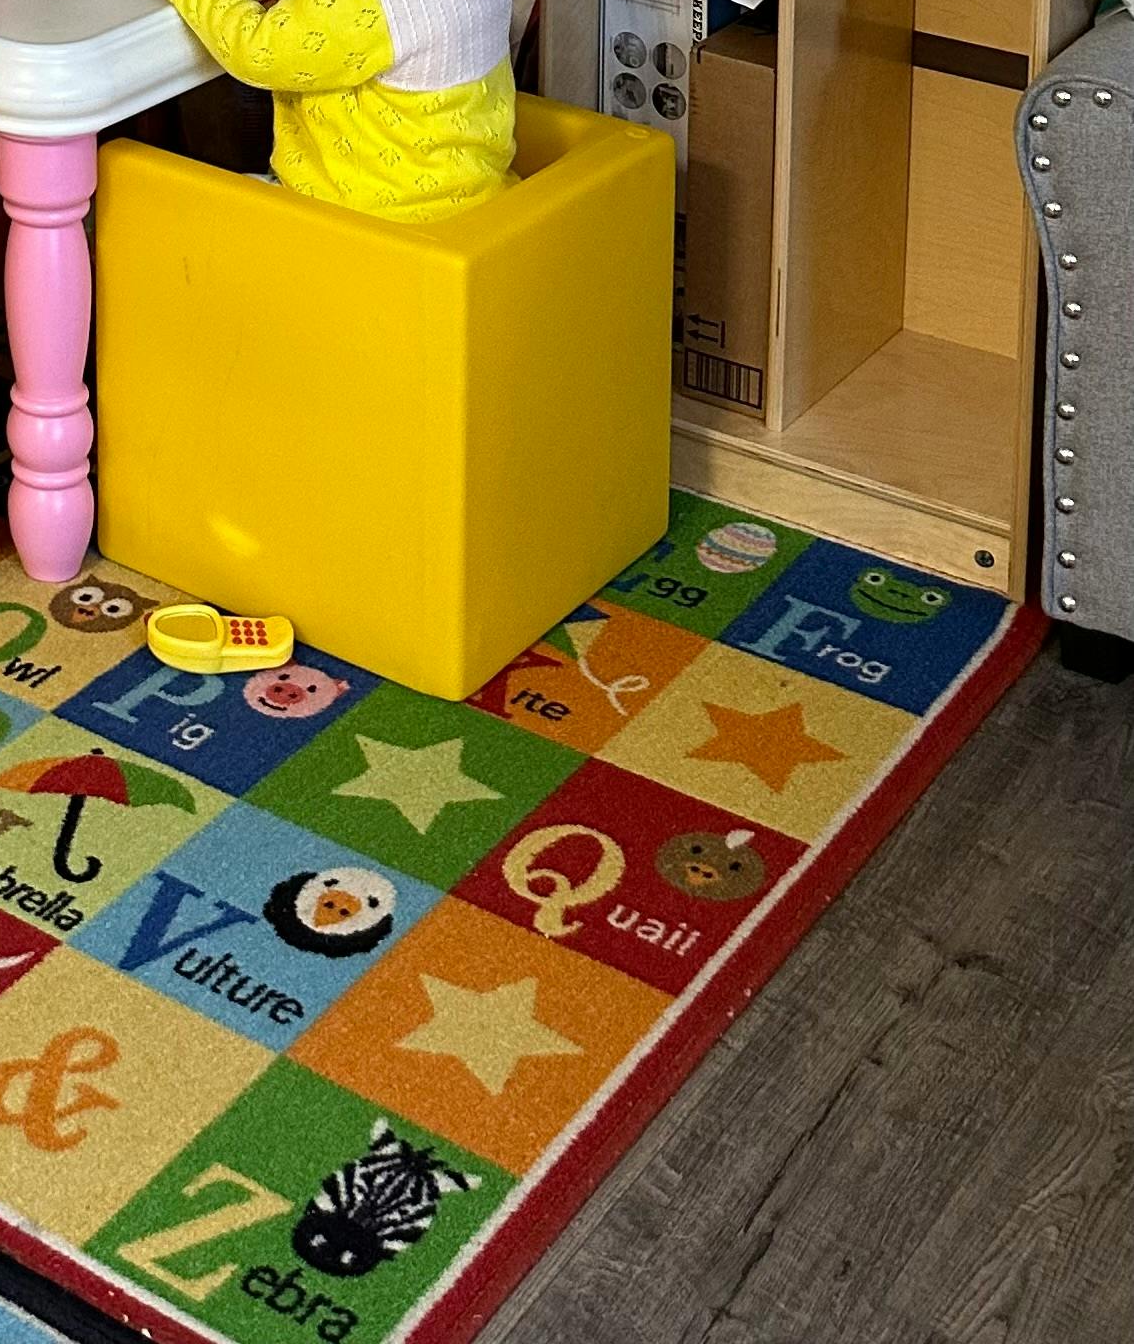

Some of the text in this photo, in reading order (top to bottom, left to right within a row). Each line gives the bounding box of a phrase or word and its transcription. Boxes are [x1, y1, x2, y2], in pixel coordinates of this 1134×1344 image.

[610, 542, 709, 610] gg
[740, 594, 891, 684] Frog
[92, 667, 226, 751] Pig
[502, 824, 702, 956] Quail
[118, 870, 306, 1026] Vulture
[117, 1162, 361, 1343] Zebra
